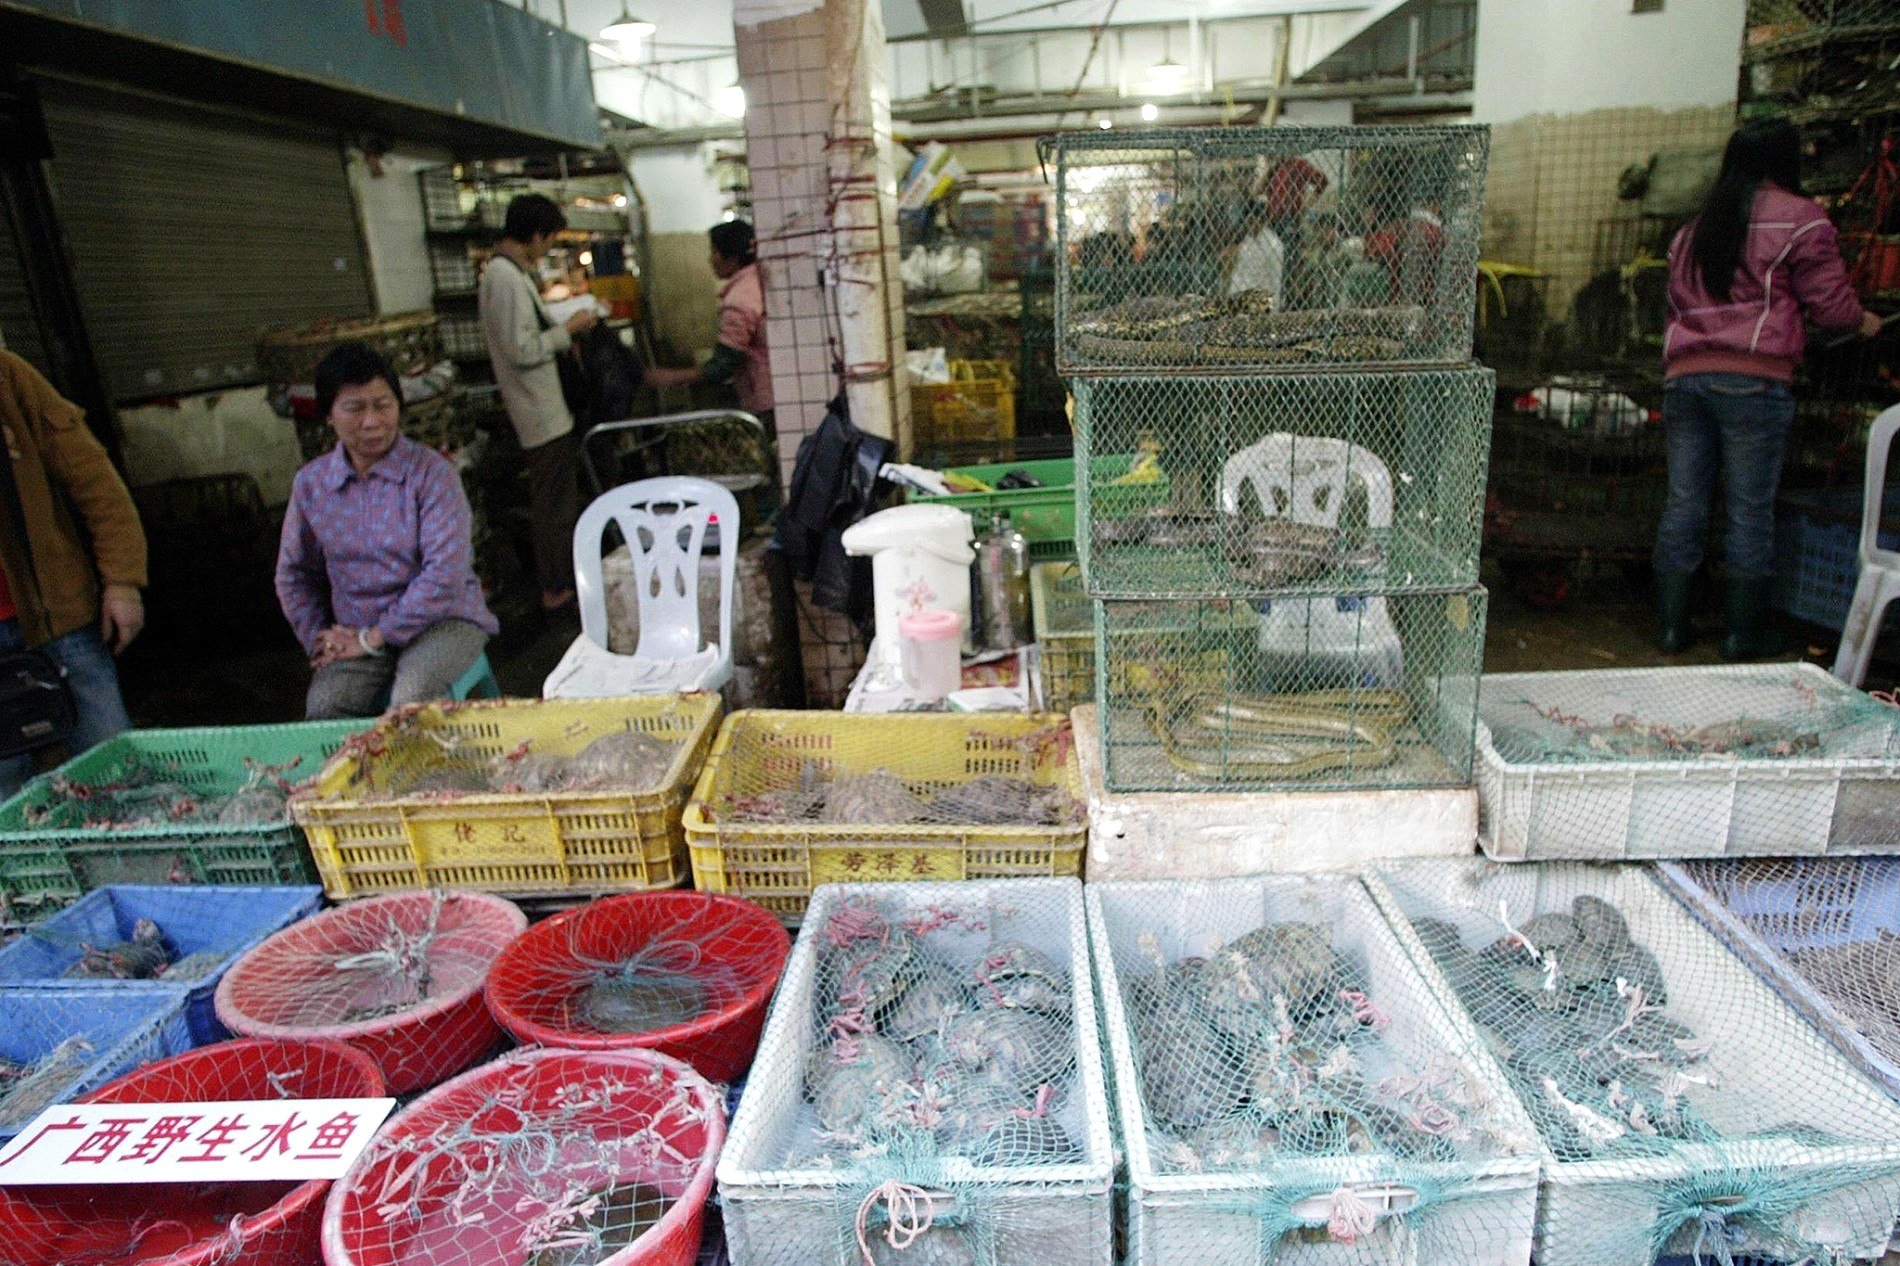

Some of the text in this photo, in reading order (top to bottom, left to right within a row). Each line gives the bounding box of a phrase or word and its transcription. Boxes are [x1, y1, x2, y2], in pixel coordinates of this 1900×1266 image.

[0, 1110, 362, 1167] 广西野生水鱼
